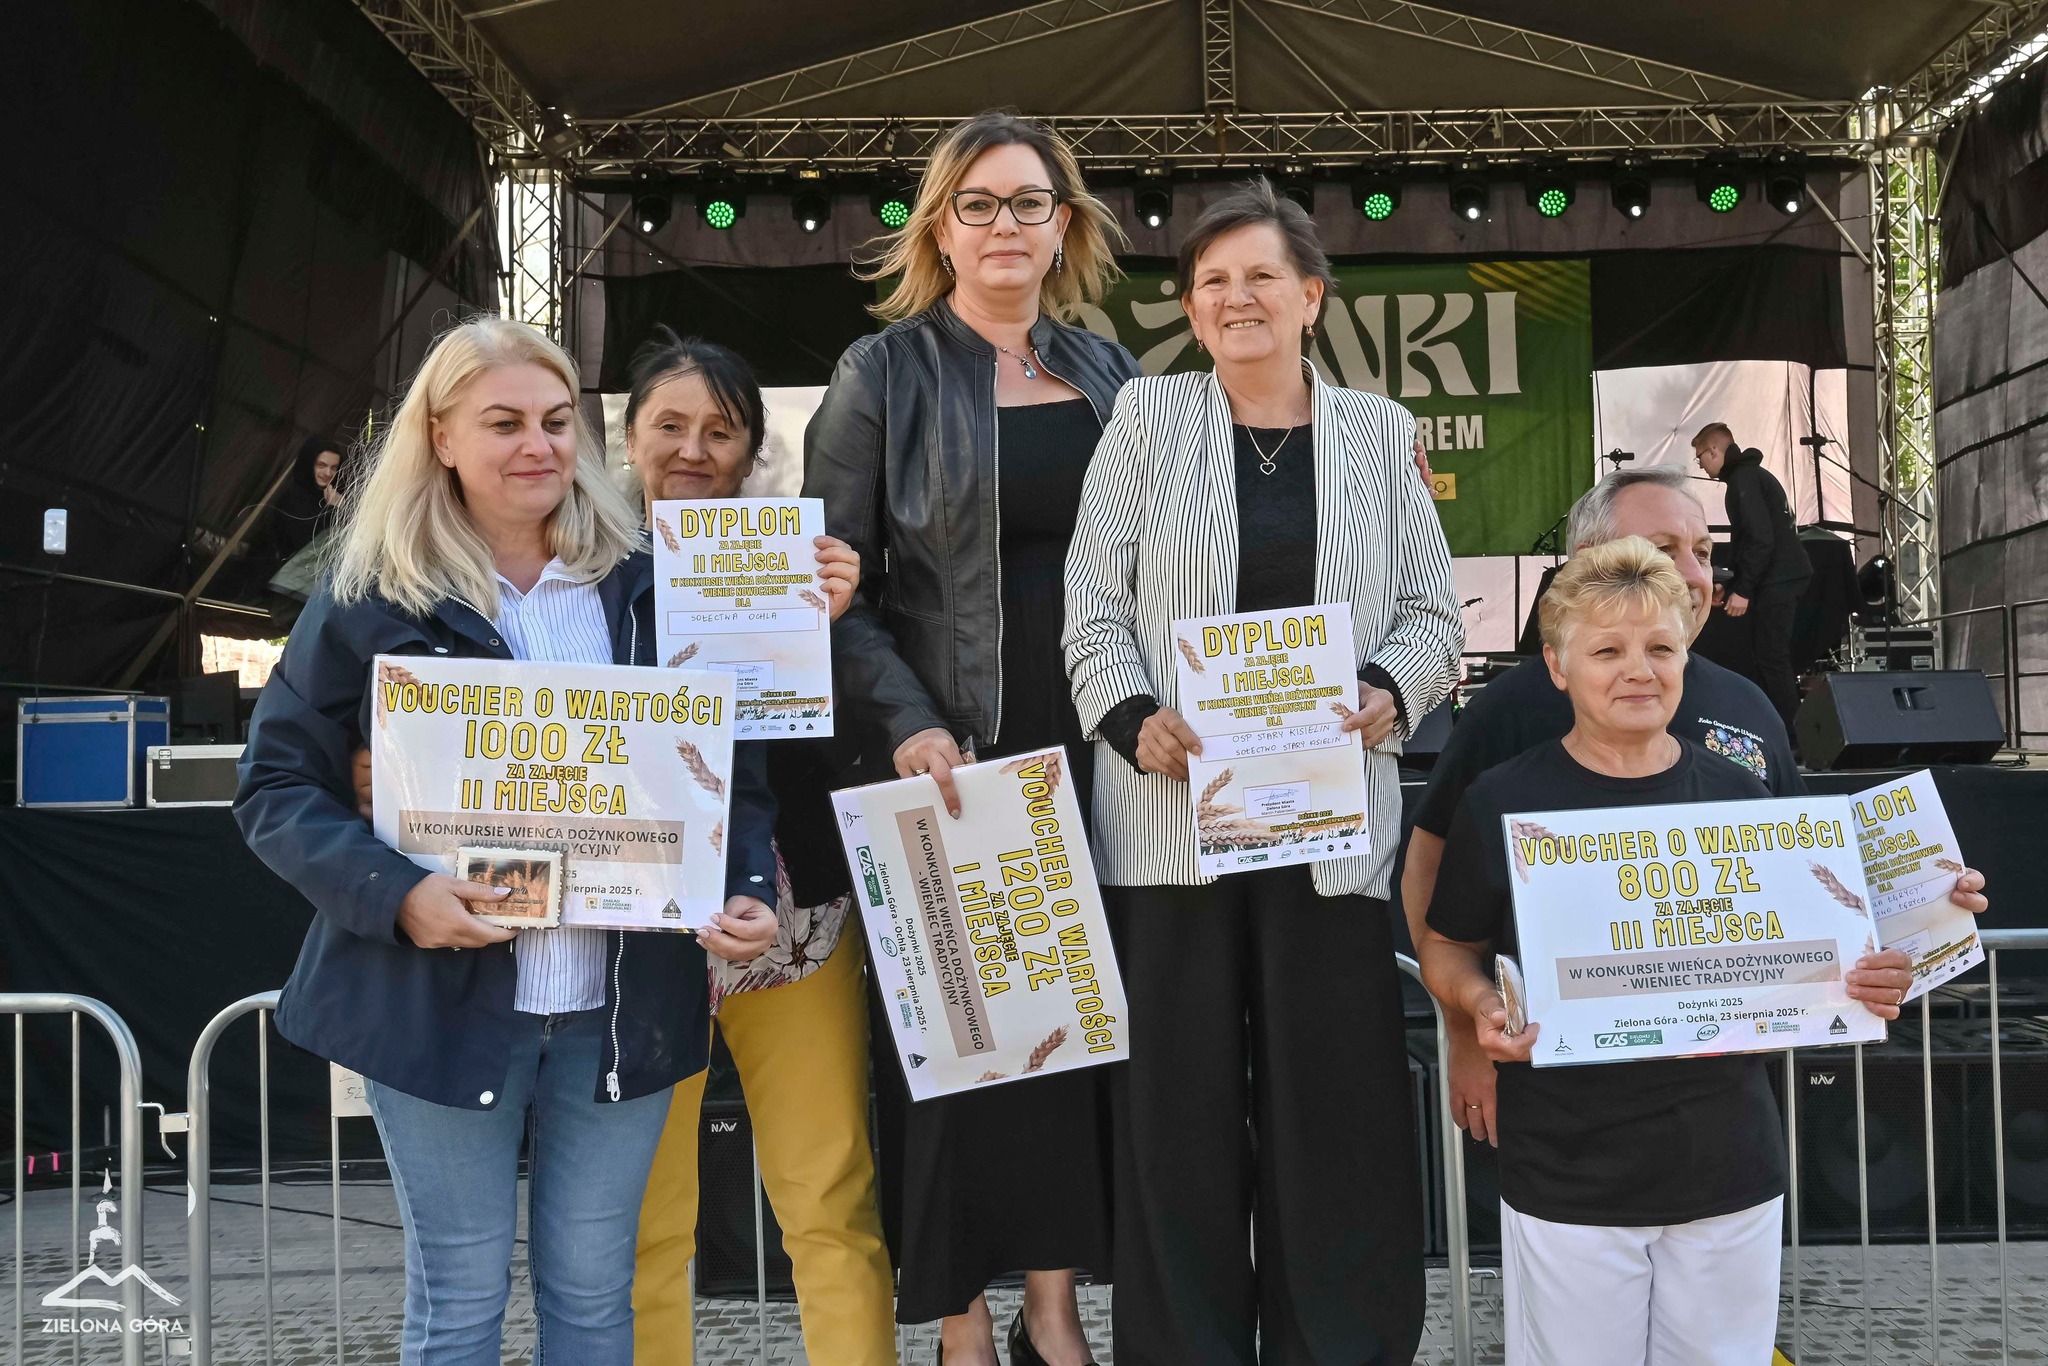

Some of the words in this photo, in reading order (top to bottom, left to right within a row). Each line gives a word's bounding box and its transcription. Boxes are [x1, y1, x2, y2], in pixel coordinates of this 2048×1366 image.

[681, 507, 800, 538] DYPLOM
[719, 541, 729, 550] ZA
[730, 540, 762, 552] ZAJĘCIE
[693, 555, 706, 573] II
[711, 552, 789, 573] MIEJSCA
[670, 578, 678, 587] W
[680, 577, 723, 587] KONKURSIE
[724, 574, 754, 586] WIEŃCA
[755, 573, 813, 585] DOŻYNKOWEGO
[702, 587, 735, 597] WIENIEC
[736, 586, 788, 596] NOWOCZESNY
[735, 598, 751, 607] DLA
[1203, 615, 1327, 658] DYPLOM
[1244, 657, 1255, 667] ZA
[1256, 653, 1289, 667] ZAJĘCIE
[1222, 674, 1230, 693] I
[1234, 665, 1315, 692] MIEJSCA
[384, 682, 523, 716] VOUCHER
[534, 688, 553, 718] O
[565, 686, 722, 726] WARTOŚCI
[1198, 701, 1206, 711] W
[1206, 696, 1252, 710] KONKURSIE
[1252, 691, 1284, 705] WIEŃCA
[1284, 686, 1343, 701] DOŻYNKOWEGO
[1234, 706, 1268, 718] WIENIEC
[1268, 700, 1316, 715] TRADYCYJNY
[1266, 717, 1283, 727] DLA
[465, 720, 566, 762] 1000
[582, 724, 629, 764] ZŁ
[1232, 734, 1252, 743] OSP
[1257, 731, 1284, 741] STARY
[1289, 725, 1330, 737] KISIELIN
[1236, 744, 1277, 756] SOŁECTWO
[1283, 741, 1305, 751] STARY
[507, 763, 525, 779] ZA
[529, 764, 588, 784] ZAJĘCIE
[461, 779, 482, 810] II
[494, 780, 626, 815] MIEJSCA
[409, 822, 421, 834] W
[424, 823, 504, 837] KONKURSIE
[507, 824, 563, 839] WIEŃCA
[568, 827, 679, 843] DOŻYNKOWEGO
[916, 818, 928, 831] W
[1018, 762, 1072, 891] VOUCHER
[535, 841, 621, 857] TRADYCYJNY
[1519, 831, 1658, 866] VOUCHER
[1667, 828, 1686, 856] O
[1695, 813, 1844, 854] WARTOŚCI
[1860, 829, 1920, 863] IEJSCA
[857, 847, 875, 877] CZAS
[1889, 843, 1943, 868] DOŻYNKOWEGO
[878, 862, 892, 895] Zielona
[920, 834, 946, 904] KONKURSIE
[953, 862, 980, 874] I
[1618, 860, 1699, 901] 800
[1711, 857, 1761, 894] ZŁ
[566, 885, 607, 895] sierpnia
[609, 886, 632, 894] 2025
[998, 848, 1050, 937] 1200
[1877, 881, 1894, 893] DLA
[888, 897, 898, 919] Góra
[990, 891, 1005, 909] ZA
[1052, 899, 1079, 917] O
[1655, 902, 1673, 916] ZA
[1676, 897, 1733, 917] ZAJĘCIE
[894, 926, 906, 955] Ochla,
[919, 877, 940, 929] WIENIEC
[932, 931, 959, 1006] TRADYCYJNY
[939, 906, 959, 956] WIEŃCA
[957, 880, 1011, 998] MIEJSCA
[995, 910, 1019, 962] ZAJĘCIE
[1610, 920, 1643, 950] III
[1653, 911, 1784, 947] MIEJSCA
[905, 918, 921, 954] Dożynki
[915, 955, 926, 976] 2025
[902, 956, 911, 966] 23
[1022, 946, 1063, 991] ZŁ
[1569, 968, 1582, 979] W
[1586, 962, 1664, 978] KONKURSIE
[1667, 957, 1722, 972] WIEŃCA
[1726, 951, 1834, 968] DOŻYNKOWEGO
[905, 968, 920, 1004] sierpnia
[1058, 922, 1116, 1054] WARTOŚCI
[1630, 974, 1691, 989] WIENIEC
[1695, 968, 1785, 984] TRADYCYJNY
[951, 957, 984, 1050] DOŻYNKOWEGO
[1678, 999, 1718, 1010] Dożynki
[1720, 998, 1743, 1007] 2025
[915, 1006, 927, 1026] 2025
[1614, 1019, 1651, 1028] Zielona
[1654, 1016, 1678, 1025] Góra
[1686, 1013, 1718, 1023] Ochla,
[1720, 1013, 1731, 1021] 23
[1734, 1010, 1773, 1020] sierpnia
[1776, 1008, 1798, 1017] 2025
[920, 1026, 928, 1034] r.
[1596, 1033, 1629, 1047] CZAS
